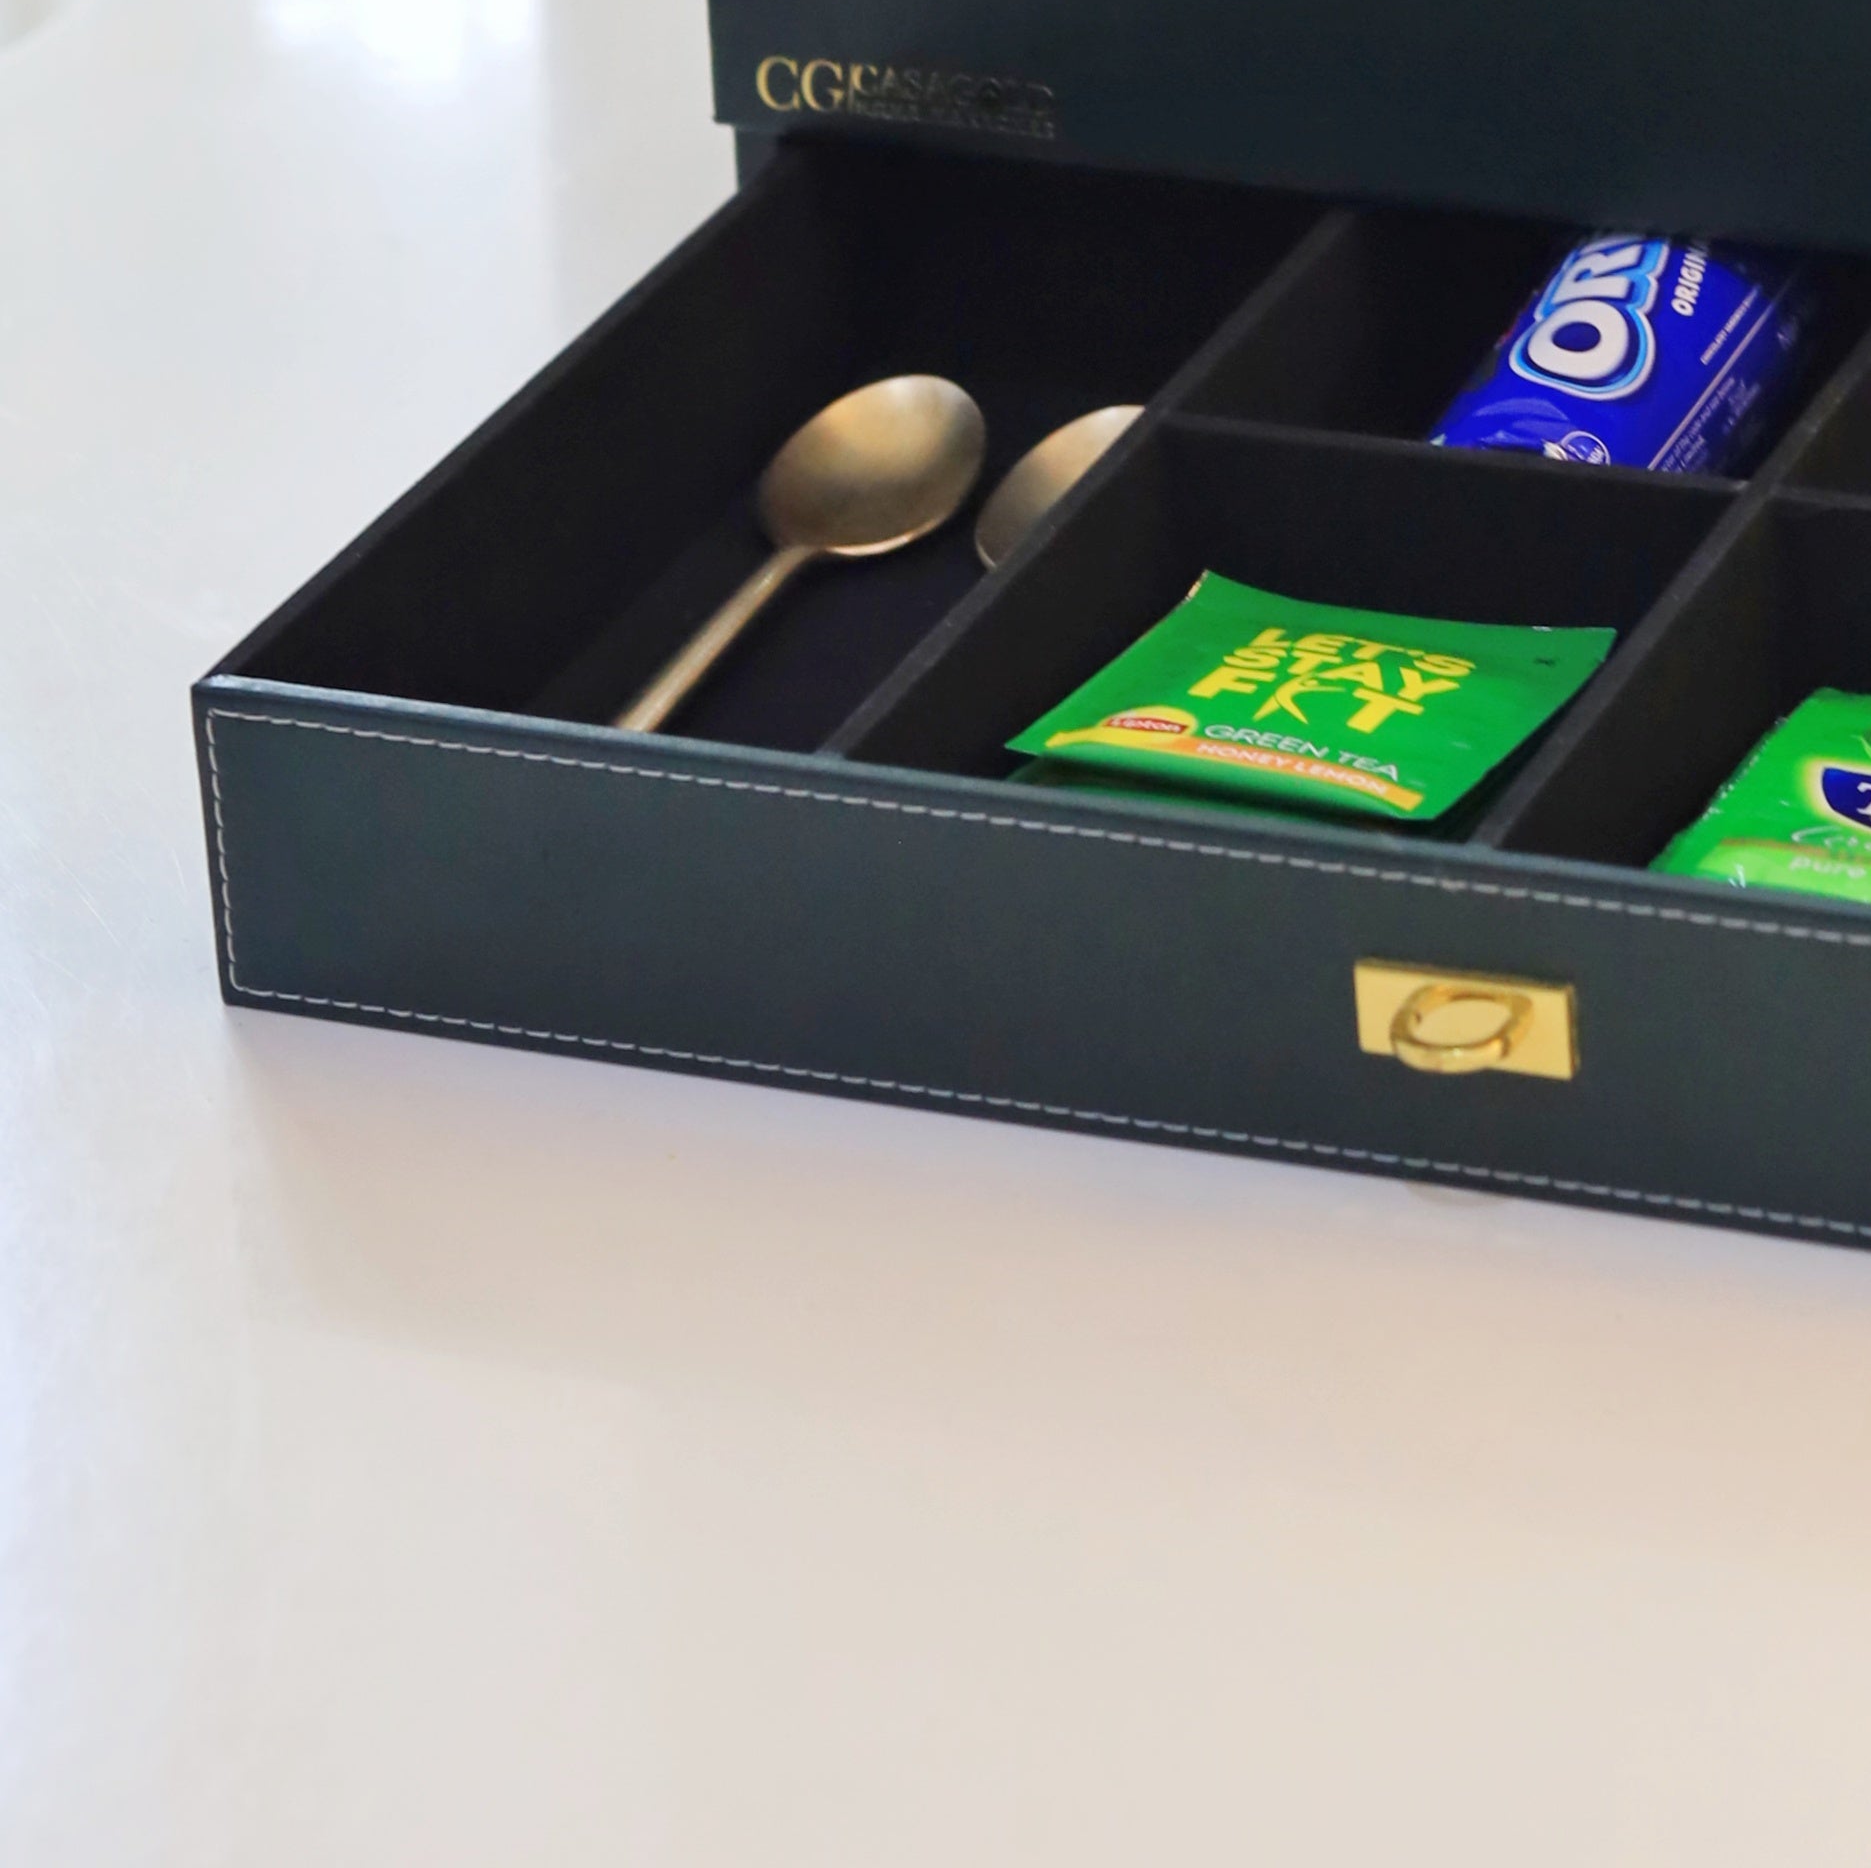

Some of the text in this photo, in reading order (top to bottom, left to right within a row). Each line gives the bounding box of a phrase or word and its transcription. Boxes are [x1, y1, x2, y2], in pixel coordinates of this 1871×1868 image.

[1670, 236, 1709, 317] ORIGIN
[1527, 235, 1644, 379] OR
[1223, 647, 1460, 701] STAY
[1197, 743, 1387, 795] HONEY LEMON
[1204, 724, 1399, 782] GREEN TEA
